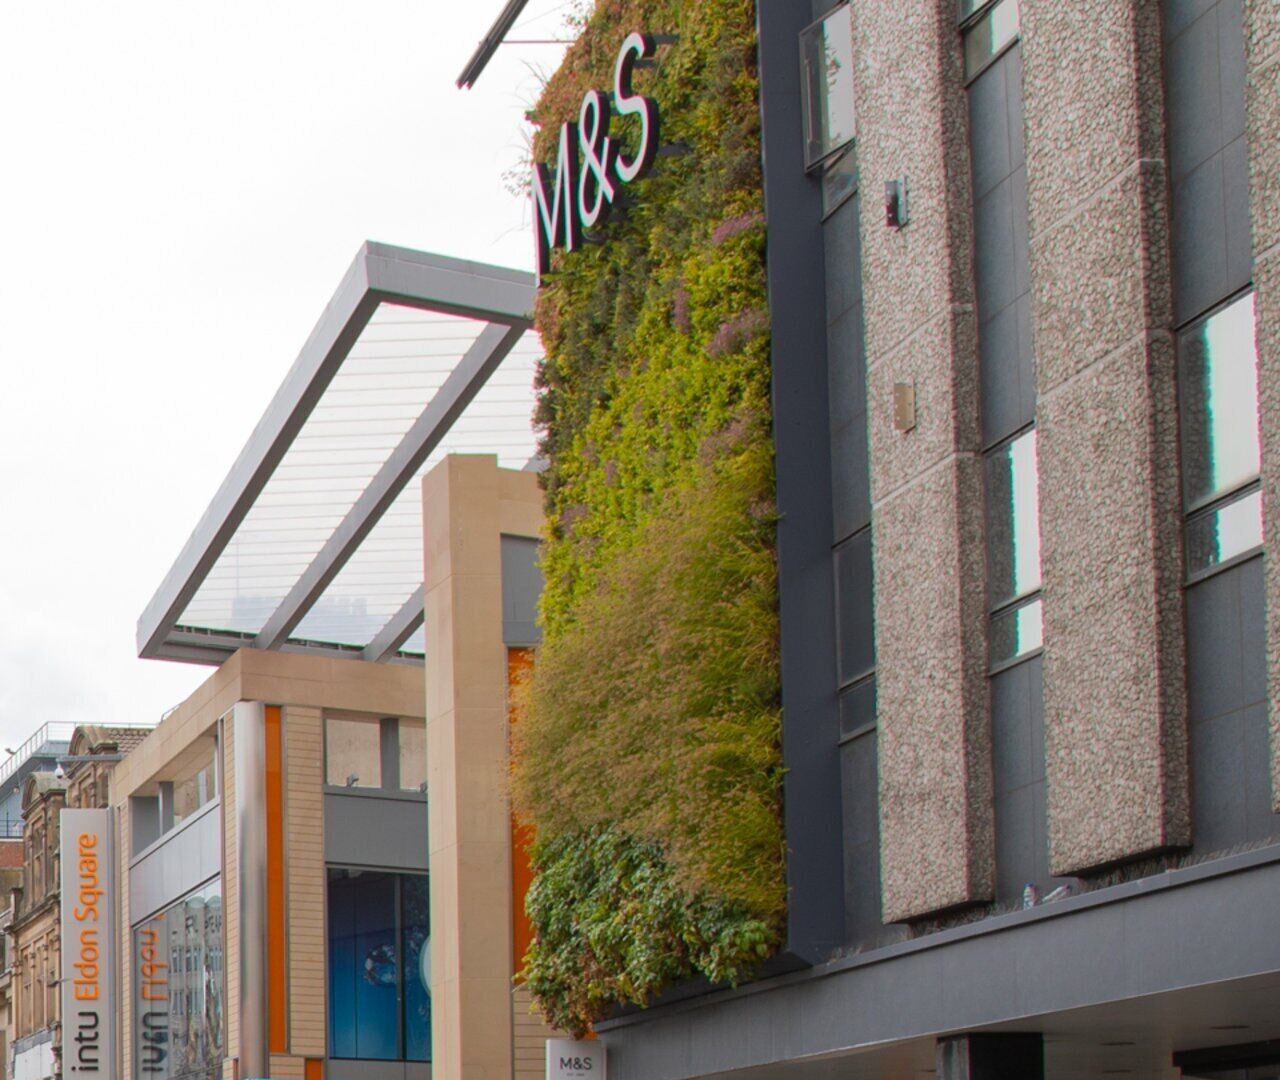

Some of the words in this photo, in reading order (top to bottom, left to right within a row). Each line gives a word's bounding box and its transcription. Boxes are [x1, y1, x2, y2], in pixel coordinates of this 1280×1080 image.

[532, 32, 652, 288] M&S
[74, 832, 104, 922] Square
[73, 928, 99, 1001] Eldon
[71, 1011, 99, 1071] intu
[560, 1057, 592, 1070] M&S
